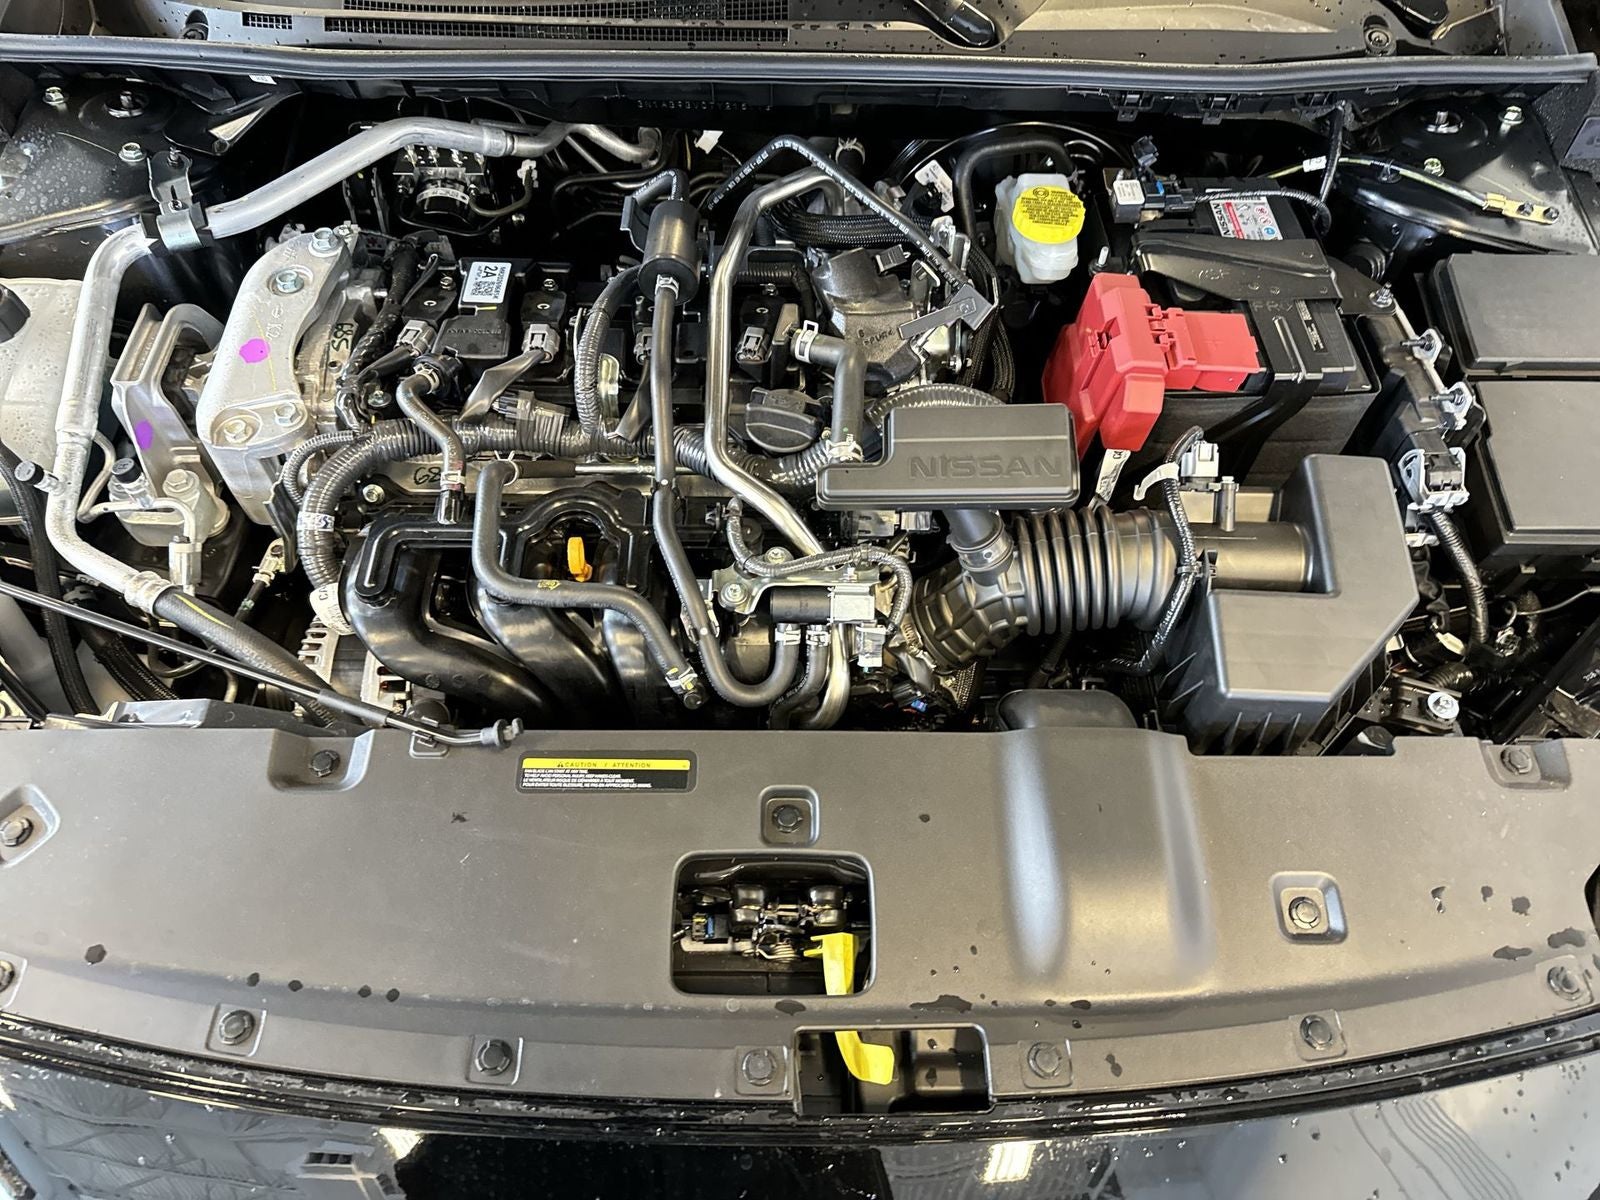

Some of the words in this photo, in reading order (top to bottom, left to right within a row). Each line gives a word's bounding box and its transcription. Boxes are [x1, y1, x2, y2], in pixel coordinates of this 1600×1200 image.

[1213, 203, 1232, 236] NISSAN
[482, 265, 498, 279] 2A
[909, 454, 1062, 480] NISSAN
